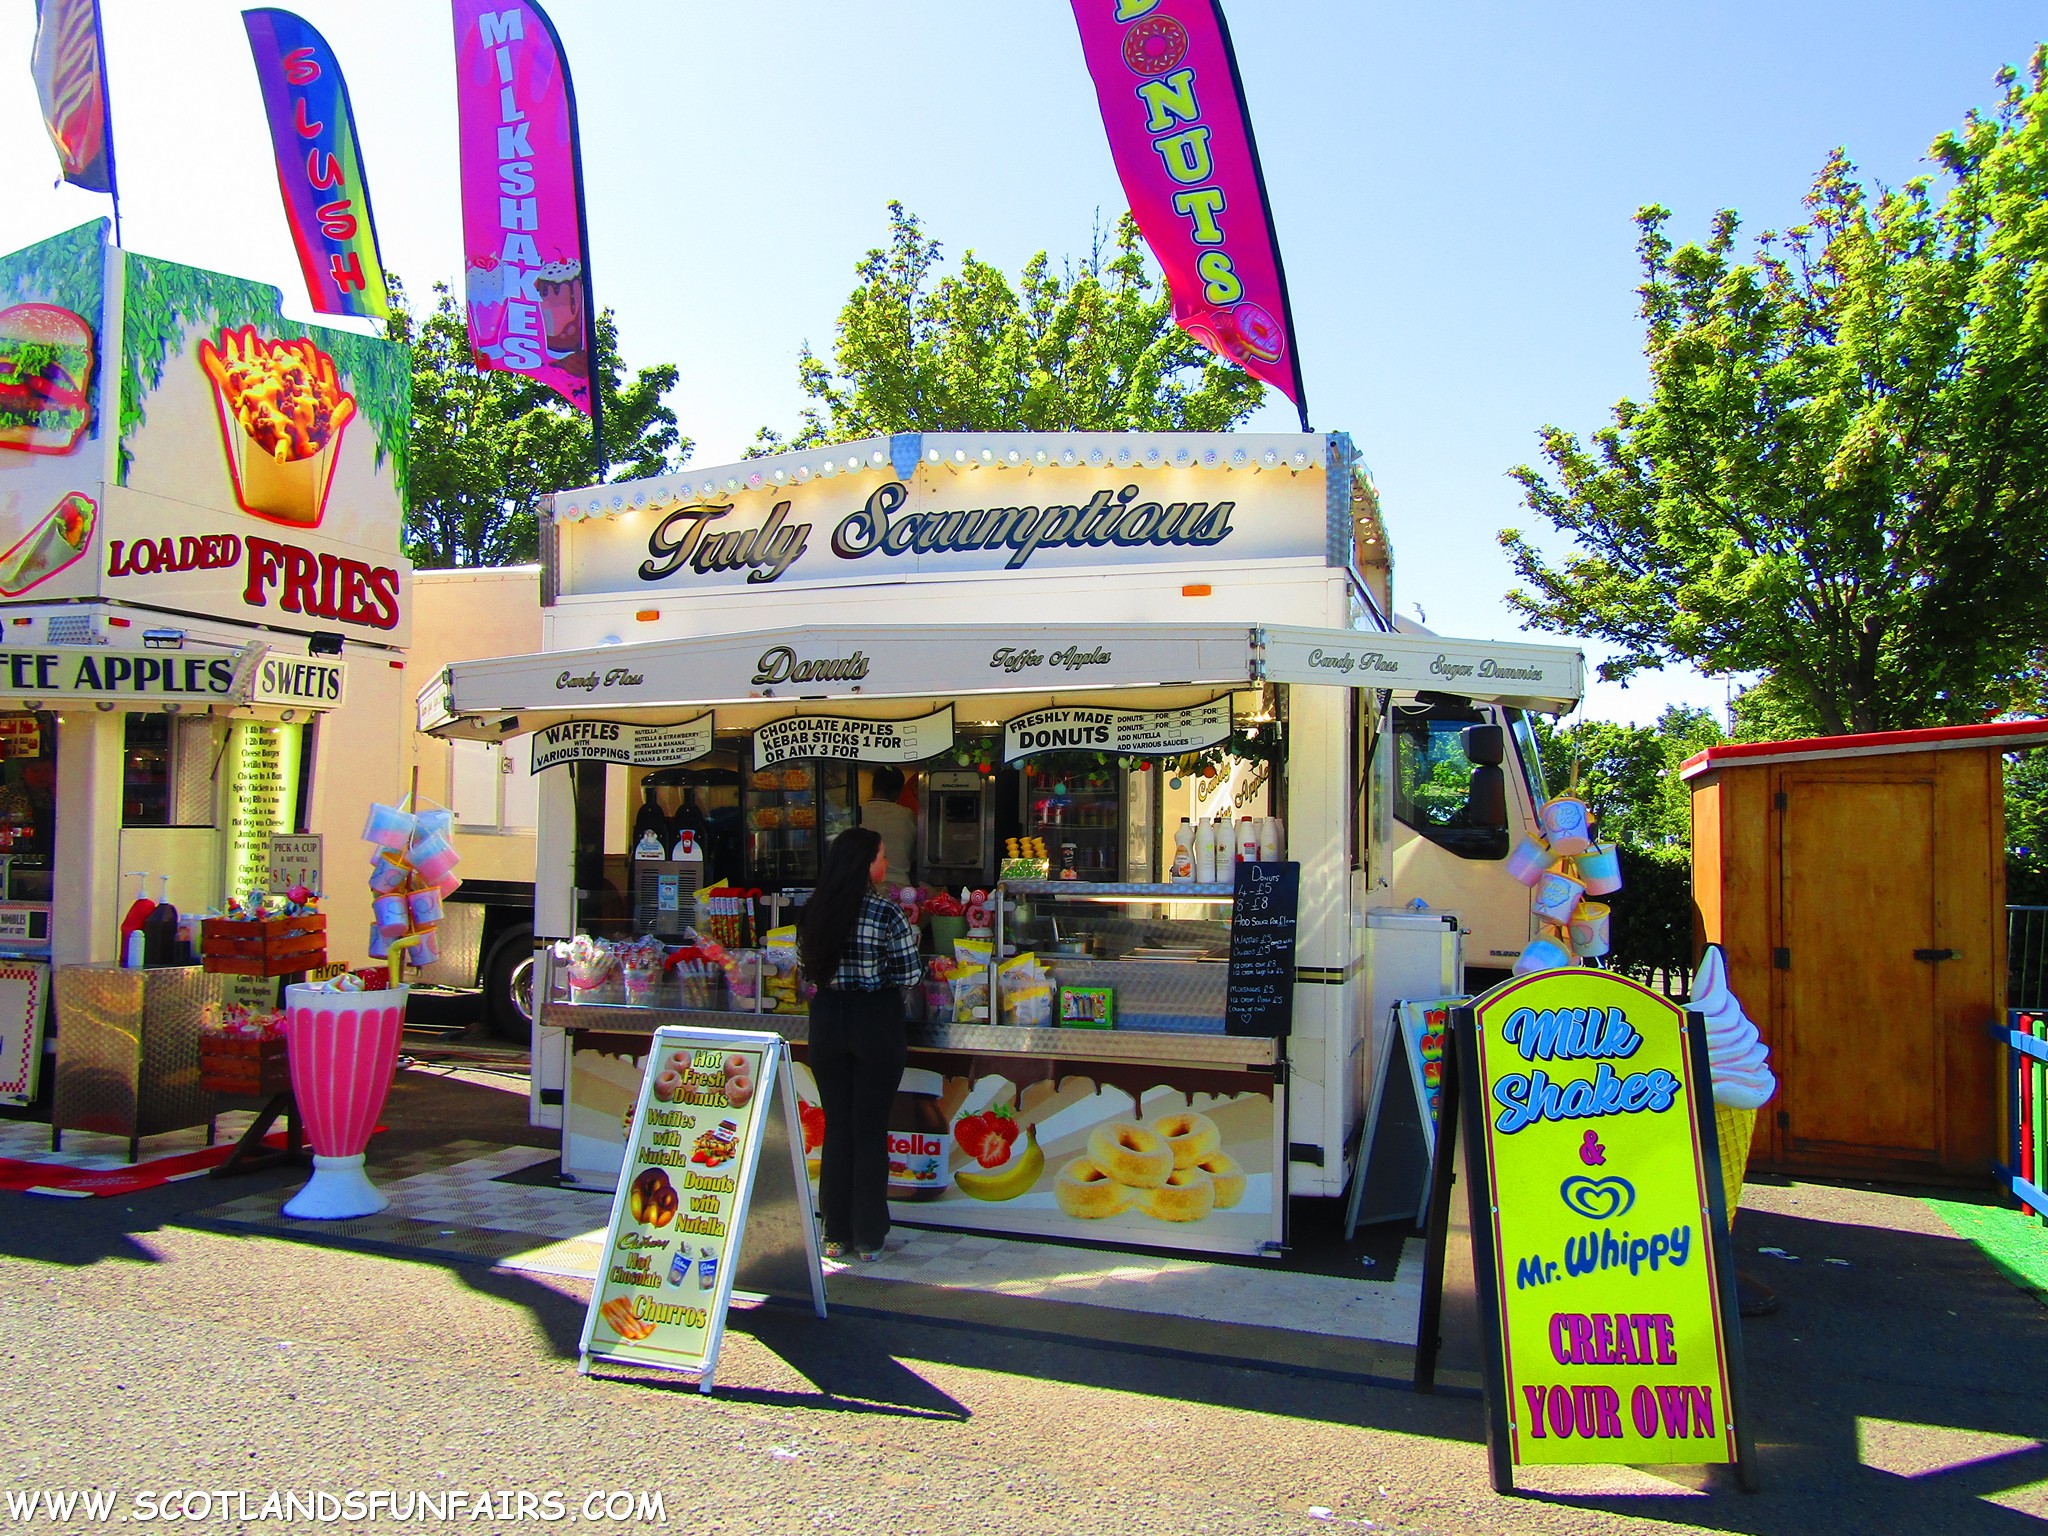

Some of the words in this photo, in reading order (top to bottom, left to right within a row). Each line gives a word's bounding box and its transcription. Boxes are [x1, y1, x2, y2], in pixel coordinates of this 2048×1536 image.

[282, 46, 366, 294] SLUSH
[478, 8, 543, 370] MILKSHAKES
[639, 501, 811, 584] Truly
[831, 482, 1236, 569] Scrumptious
[107, 534, 242, 577] LOADED
[243, 535, 400, 630] FRIES
[751, 646, 869, 684] Donuts
[990, 647, 1044, 672] Toffee
[1049, 645, 1111, 670] Apples
[1308, 649, 1354, 673] Candy
[1359, 652, 1399, 672] Floss
[1430, 654, 1472, 680] Sugar
[1477, 659, 1542, 681] Dummies
[74, 655, 235, 693] APPLES
[261, 659, 340, 700] SWEETS
[556, 671, 599, 691] Candy
[604, 669, 644, 687] Floss
[760, 720, 838, 740] CHOCOLATE
[842, 722, 893, 735] APPLES
[1010, 712, 1070, 733] FRESHLY
[1073, 712, 1113, 725] MADE
[1117, 724, 1143, 732] DONUTS
[545, 724, 620, 744] WAFFLES
[663, 732, 699, 740] STRAWBERRY
[763, 732, 808, 751] KEBAB
[812, 732, 859, 746] STICKS
[863, 736, 870, 747] 1
[874, 736, 901, 748] FOR
[1020, 726, 1109, 748] DONUTS
[1133, 732, 1160, 740] NUTELLA
[1133, 741, 1161, 749] VARIOUS
[242, 749, 261, 757] Cheese
[262, 749, 280, 758] Burger
[537, 747, 579, 766] VARIOUS
[582, 747, 630, 760] TOPPINGS
[766, 752, 784, 763] OR
[789, 744, 816, 756] ANY
[820, 745, 828, 755] 3
[832, 745, 859, 758] FOR
[1198, 760, 1231, 802] Candy
[250, 853, 265, 862] Chips
[275, 844, 291, 852] PICK
[294, 844, 299, 852] A
[302, 844, 317, 852] CUP
[1238, 885, 1247, 896] 4
[1255, 882, 1272, 895] £5
[1237, 899, 1243, 911] 8
[1251, 896, 1268, 911] £8
[1502, 1006, 1644, 1061] Milk
[694, 1051, 722, 1068] Hot
[682, 1069, 726, 1088] Fresh
[673, 1088, 729, 1108] Donuts
[1493, 1063, 1681, 1135] Shakes
[647, 1109, 696, 1129] Waffles
[653, 1130, 682, 1147] with
[887, 1134, 941, 1156] tella
[1580, 1129, 1606, 1166] &
[638, 1147, 686, 1167] Nutella
[684, 1171, 735, 1193] Donuts
[690, 1194, 720, 1214] with
[675, 1213, 725, 1237] Nutella
[626, 1252, 652, 1271] Hot
[1517, 1254, 1561, 1289] Mr.
[1565, 1225, 1690, 1277] Whippy
[610, 1265, 662, 1288] Chocolate
[632, 1294, 707, 1328] Churros
[1549, 1313, 1677, 1365] CREATE
[1523, 1385, 1623, 1438] YOUR
[1631, 1385, 1715, 1438] OWN
